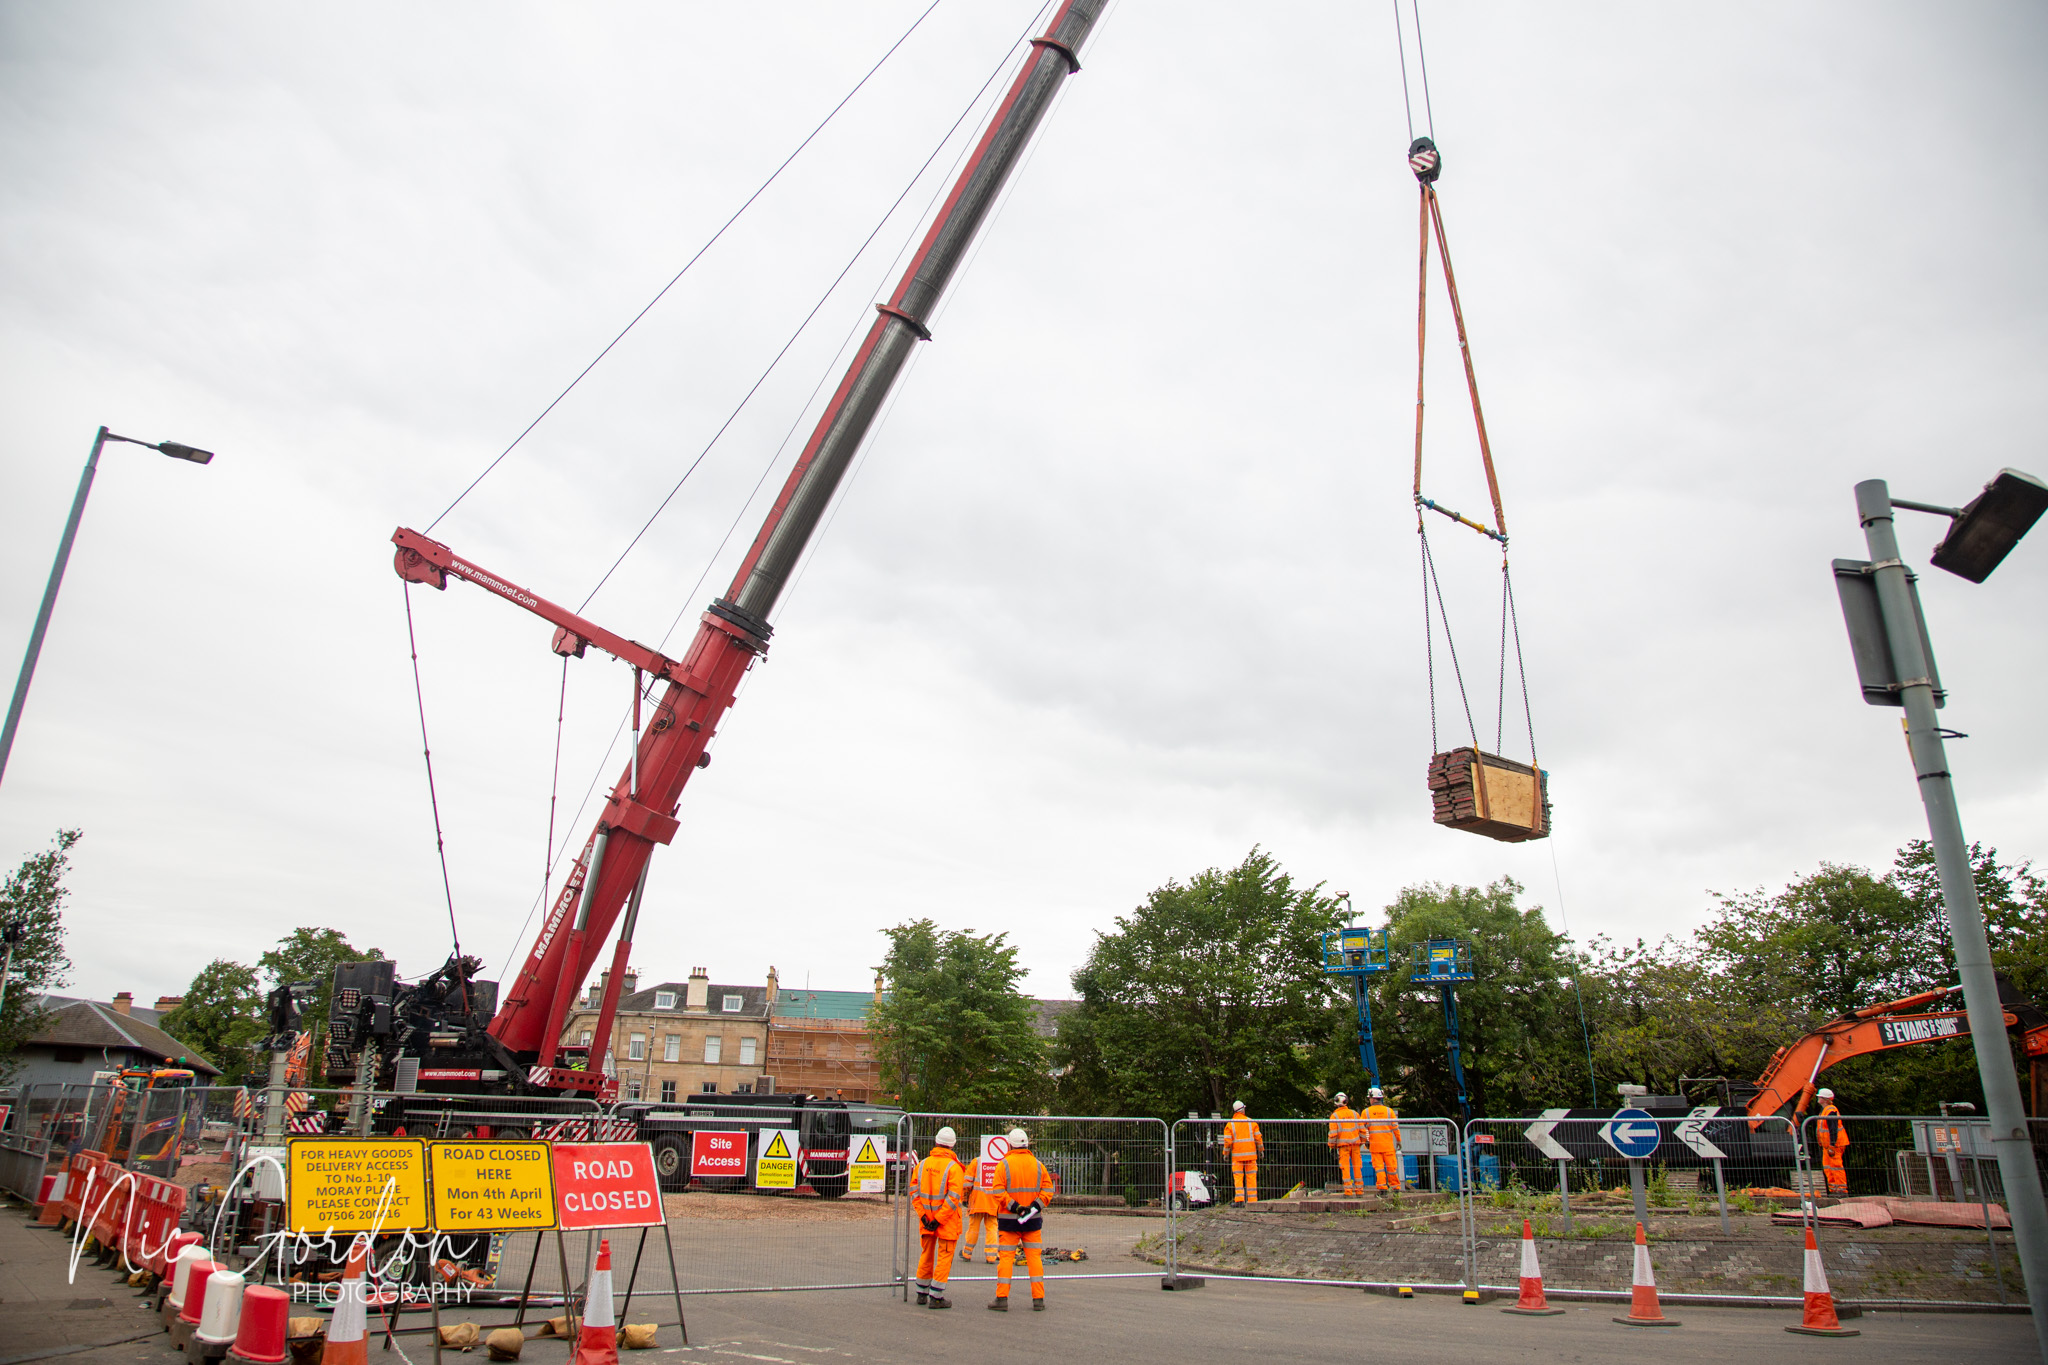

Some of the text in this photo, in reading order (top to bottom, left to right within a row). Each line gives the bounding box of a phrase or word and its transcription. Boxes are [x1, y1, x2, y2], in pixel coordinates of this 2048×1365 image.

[451, 558, 538, 608] www.mammoet.com
[533, 866, 586, 961] MAMMOET
[1884, 1023, 1895, 1041] S
[1892, 1020, 1931, 1043] EVANS
[1934, 1017, 1957, 1036] SONS
[709, 1138, 732, 1149] Site
[300, 1149, 413, 1160] FOR HEAVY GOODS
[443, 1148, 541, 1161] ROAD CLOSED
[698, 1155, 741, 1166] Access
[306, 1160, 409, 1172] DELIVERY ACCESS
[573, 1160, 634, 1180] ROAD
[760, 1162, 794, 1171] DANGER
[325, 1173, 391, 1183] TO No.1-10
[476, 1168, 512, 1180] HERE
[316, 1185, 401, 1196] MORAY PLACE
[447, 1187, 542, 1203] Mon 4th April
[307, 1196, 410, 1209] PLEASE CONTACT
[564, 1190, 652, 1212] CLOSED
[318, 1209, 401, 1221] 07506 200416
[450, 1206, 542, 1220] For 43 Weeks
